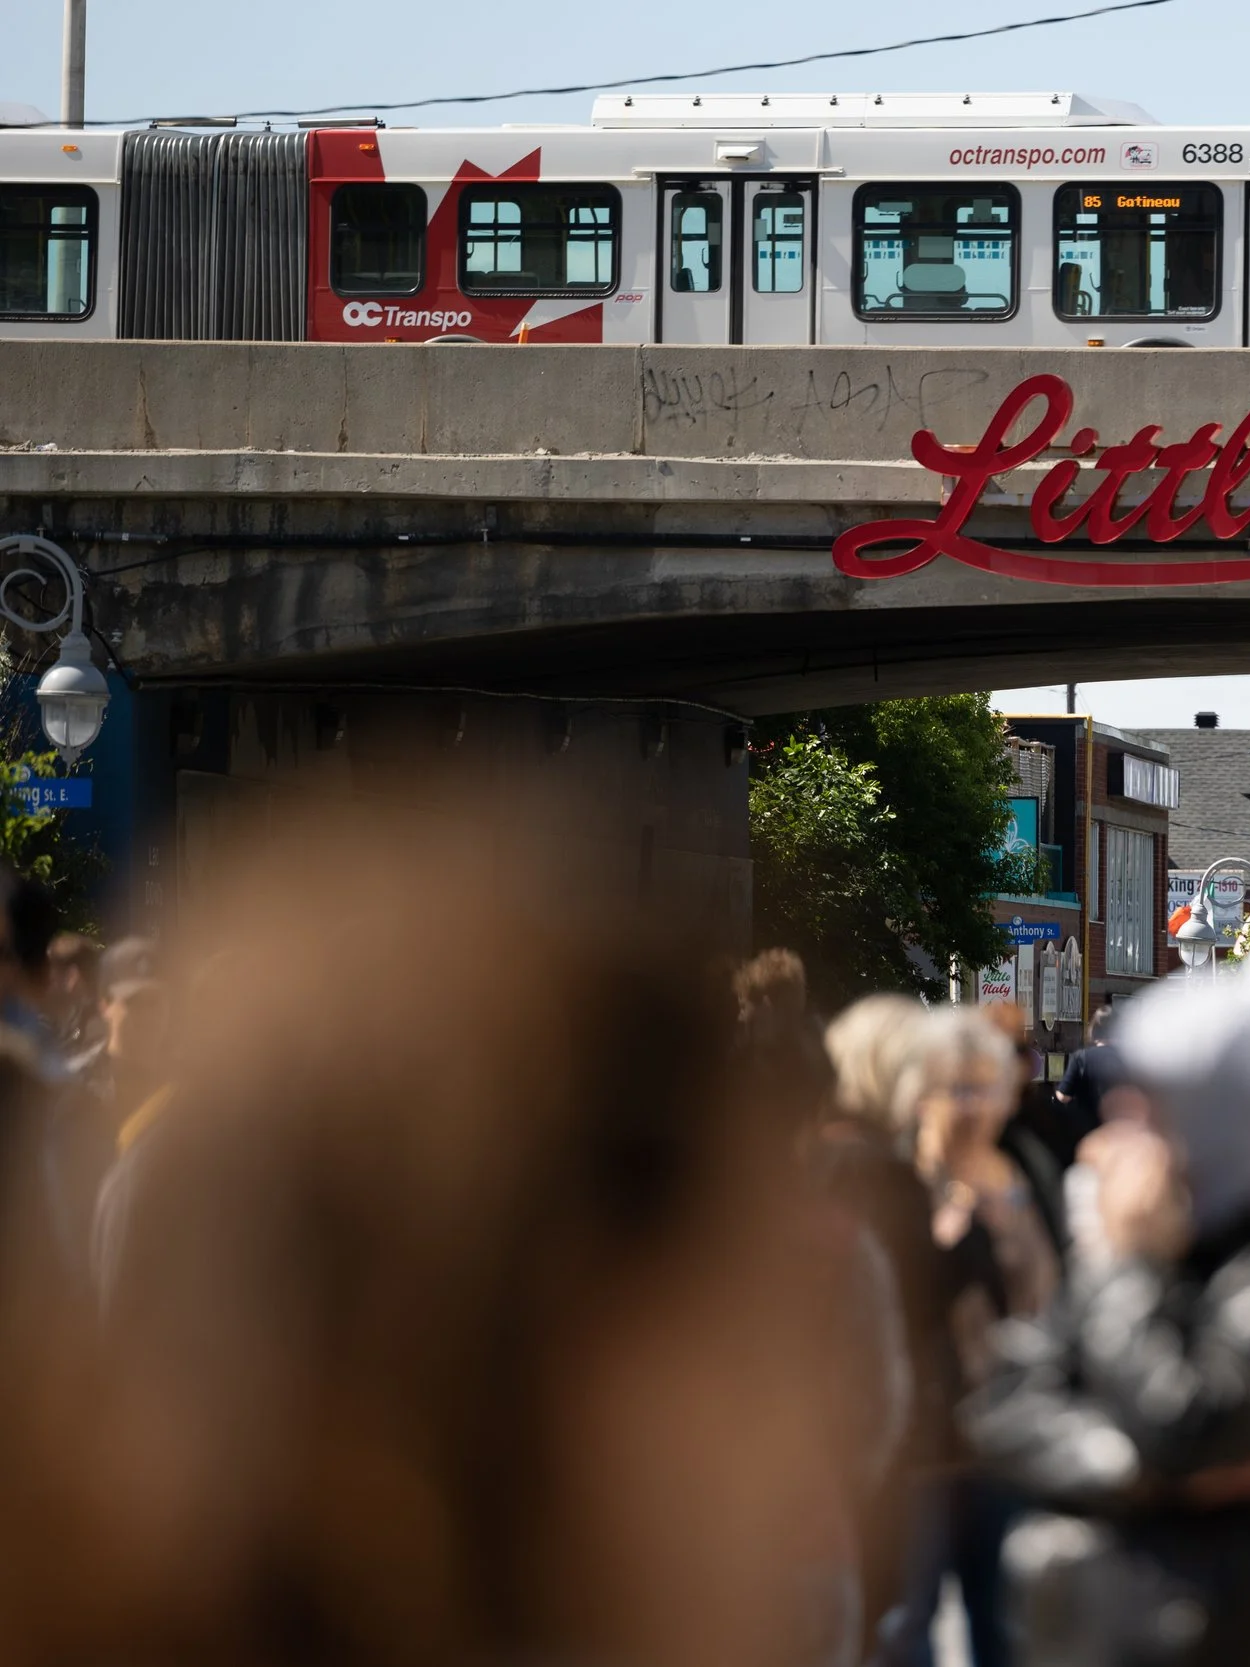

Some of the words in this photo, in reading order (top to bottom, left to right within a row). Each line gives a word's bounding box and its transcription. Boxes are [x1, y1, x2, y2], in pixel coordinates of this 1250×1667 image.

[950, 146, 1106, 169] octranspo.com
[1182, 143, 1244, 164] 6388
[1083, 196, 1101, 208] 85
[1117, 196, 1180, 208] Gatineau
[614, 294, 643, 303] pop
[383, 306, 472, 332] Transpo
[44, 788, 56, 801] St.
[60, 788, 69, 801] E.
[1008, 925, 1044, 938] Anthony
[1046, 928, 1055, 936] St.
[983, 971, 1011, 984] Little
[982, 983, 1011, 997] Italy
